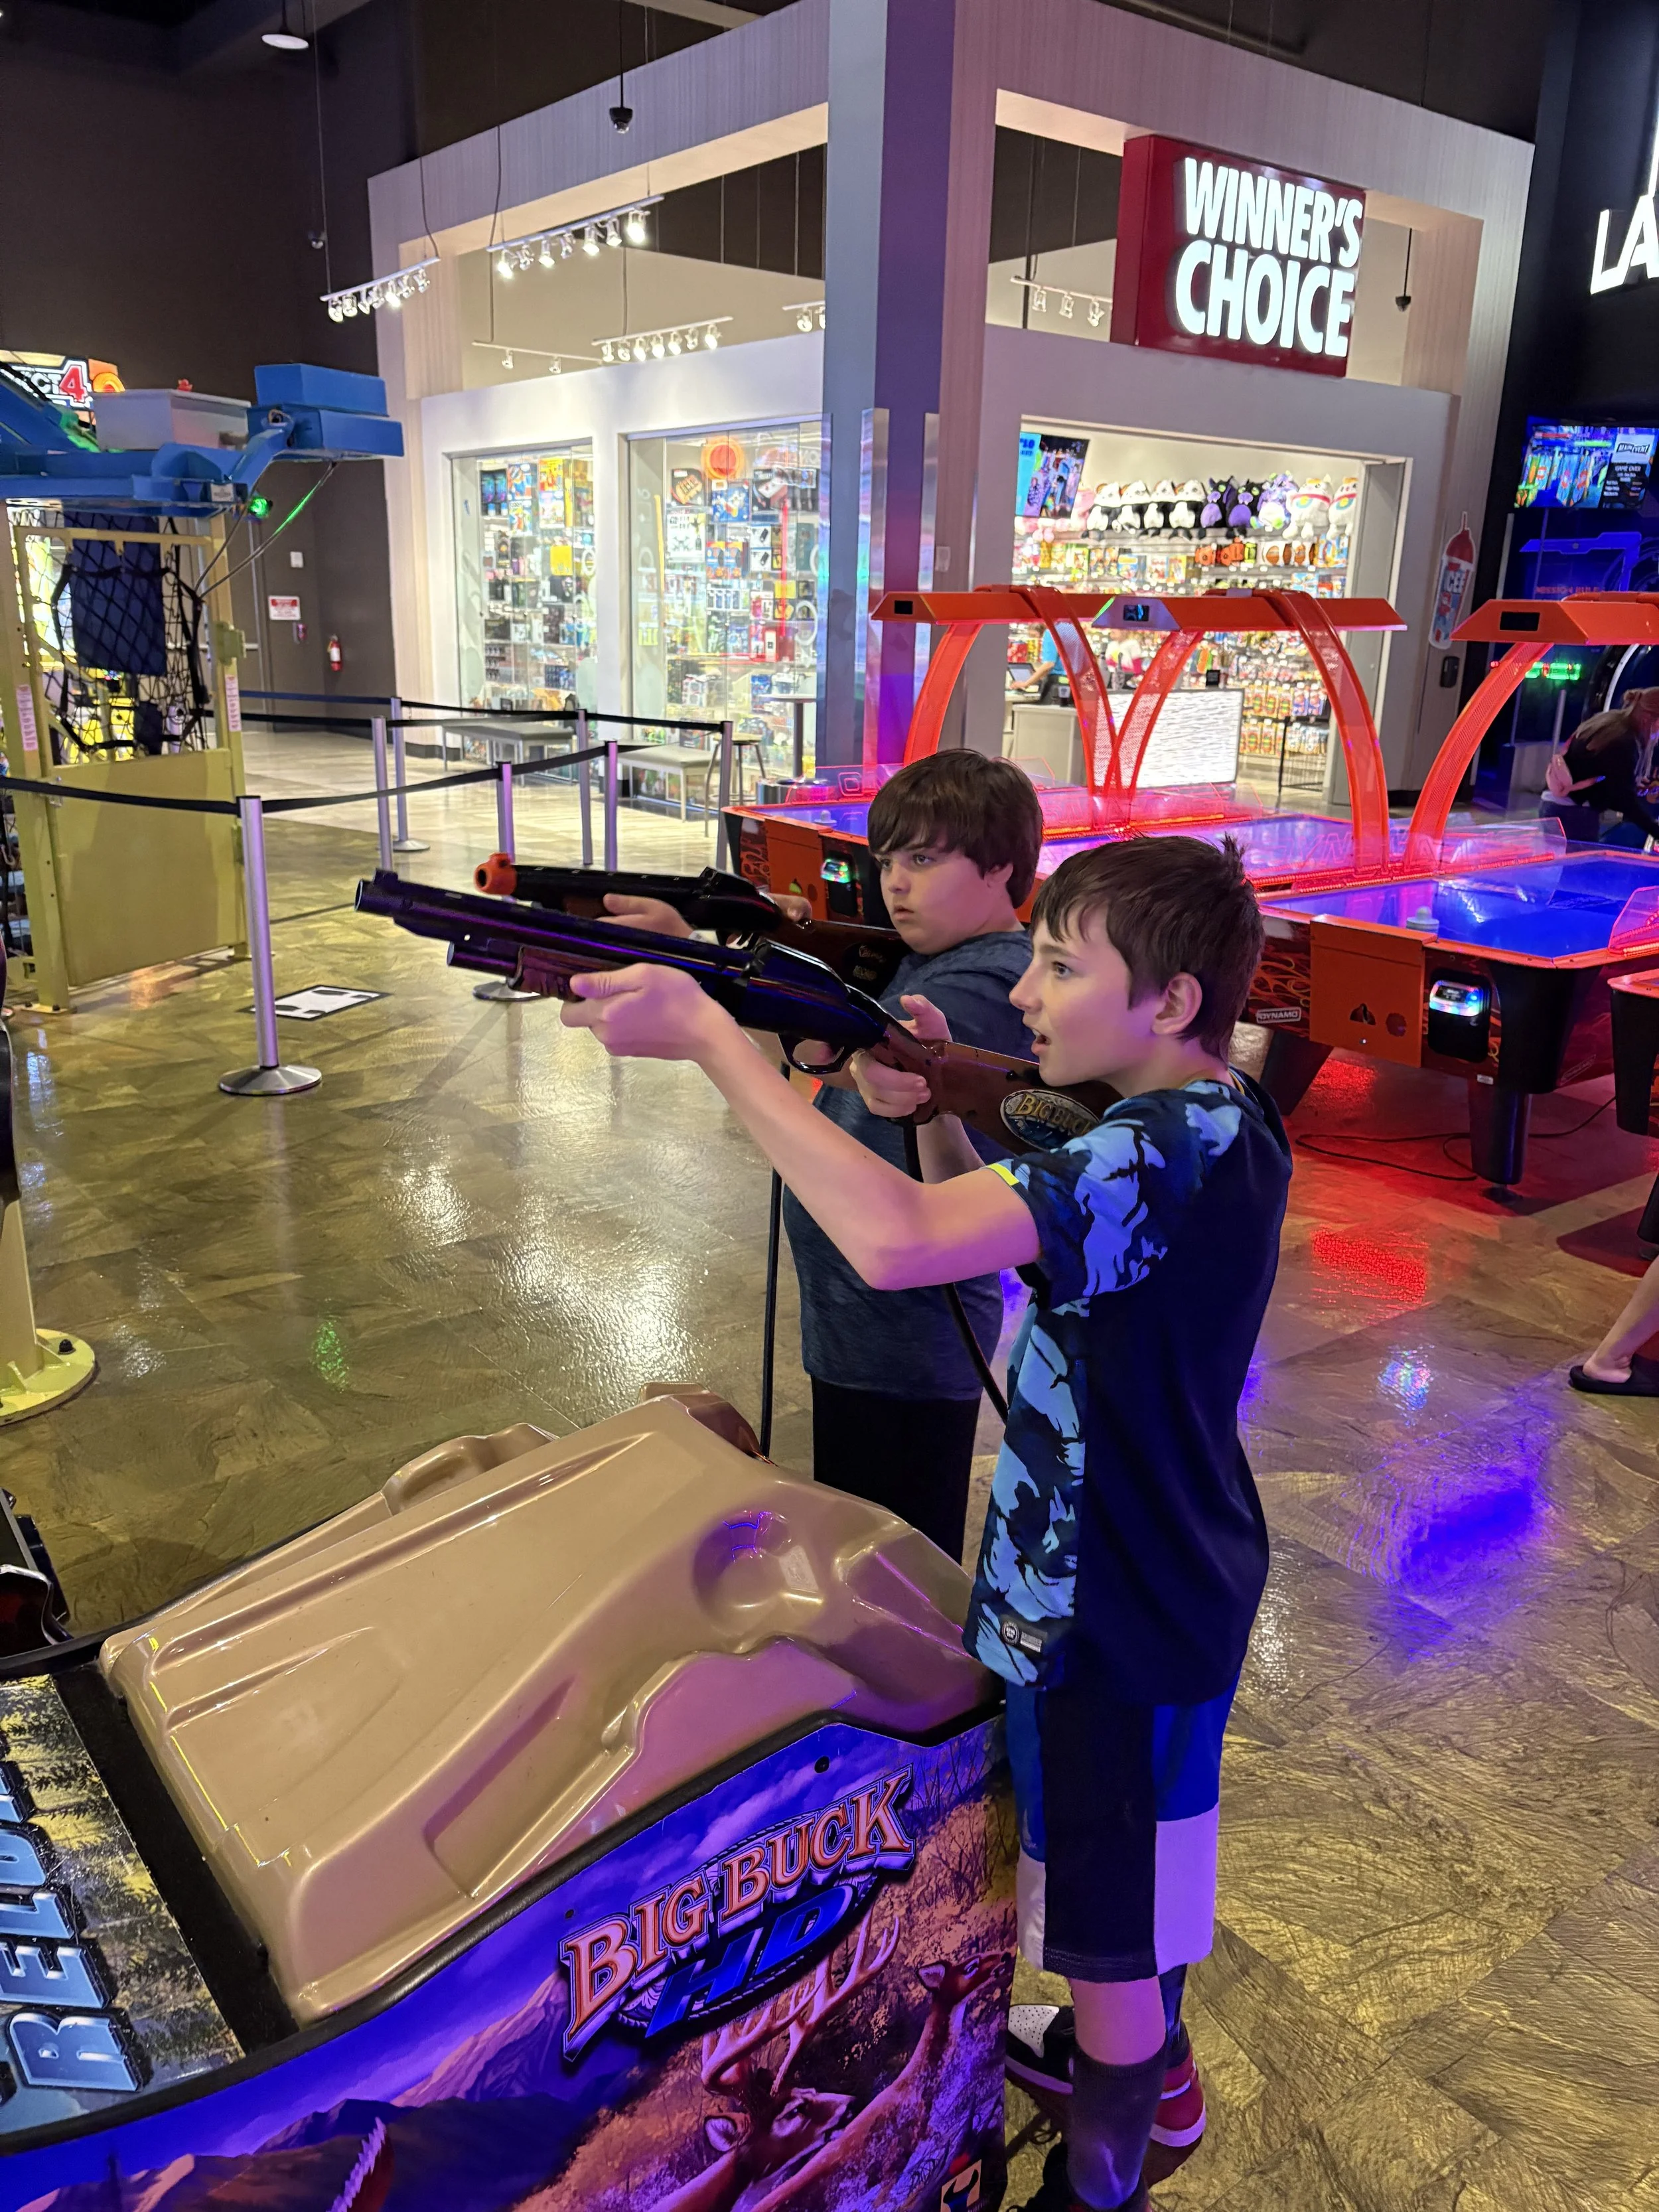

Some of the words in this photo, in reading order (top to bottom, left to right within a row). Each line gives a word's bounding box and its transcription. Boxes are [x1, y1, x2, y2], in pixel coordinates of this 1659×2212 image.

[1185, 157, 1364, 268] WINNER'S
[1175, 239, 1355, 357] CHOICE
[59, 364, 88, 403] 4
[1258, 1010, 1299, 1020] DYNAMO
[1015, 1093, 1052, 1120] BIG
[564, 1874, 710, 2043] BIG
[720, 1770, 912, 1921] BUCK
[645, 1884, 859, 2038] HD
